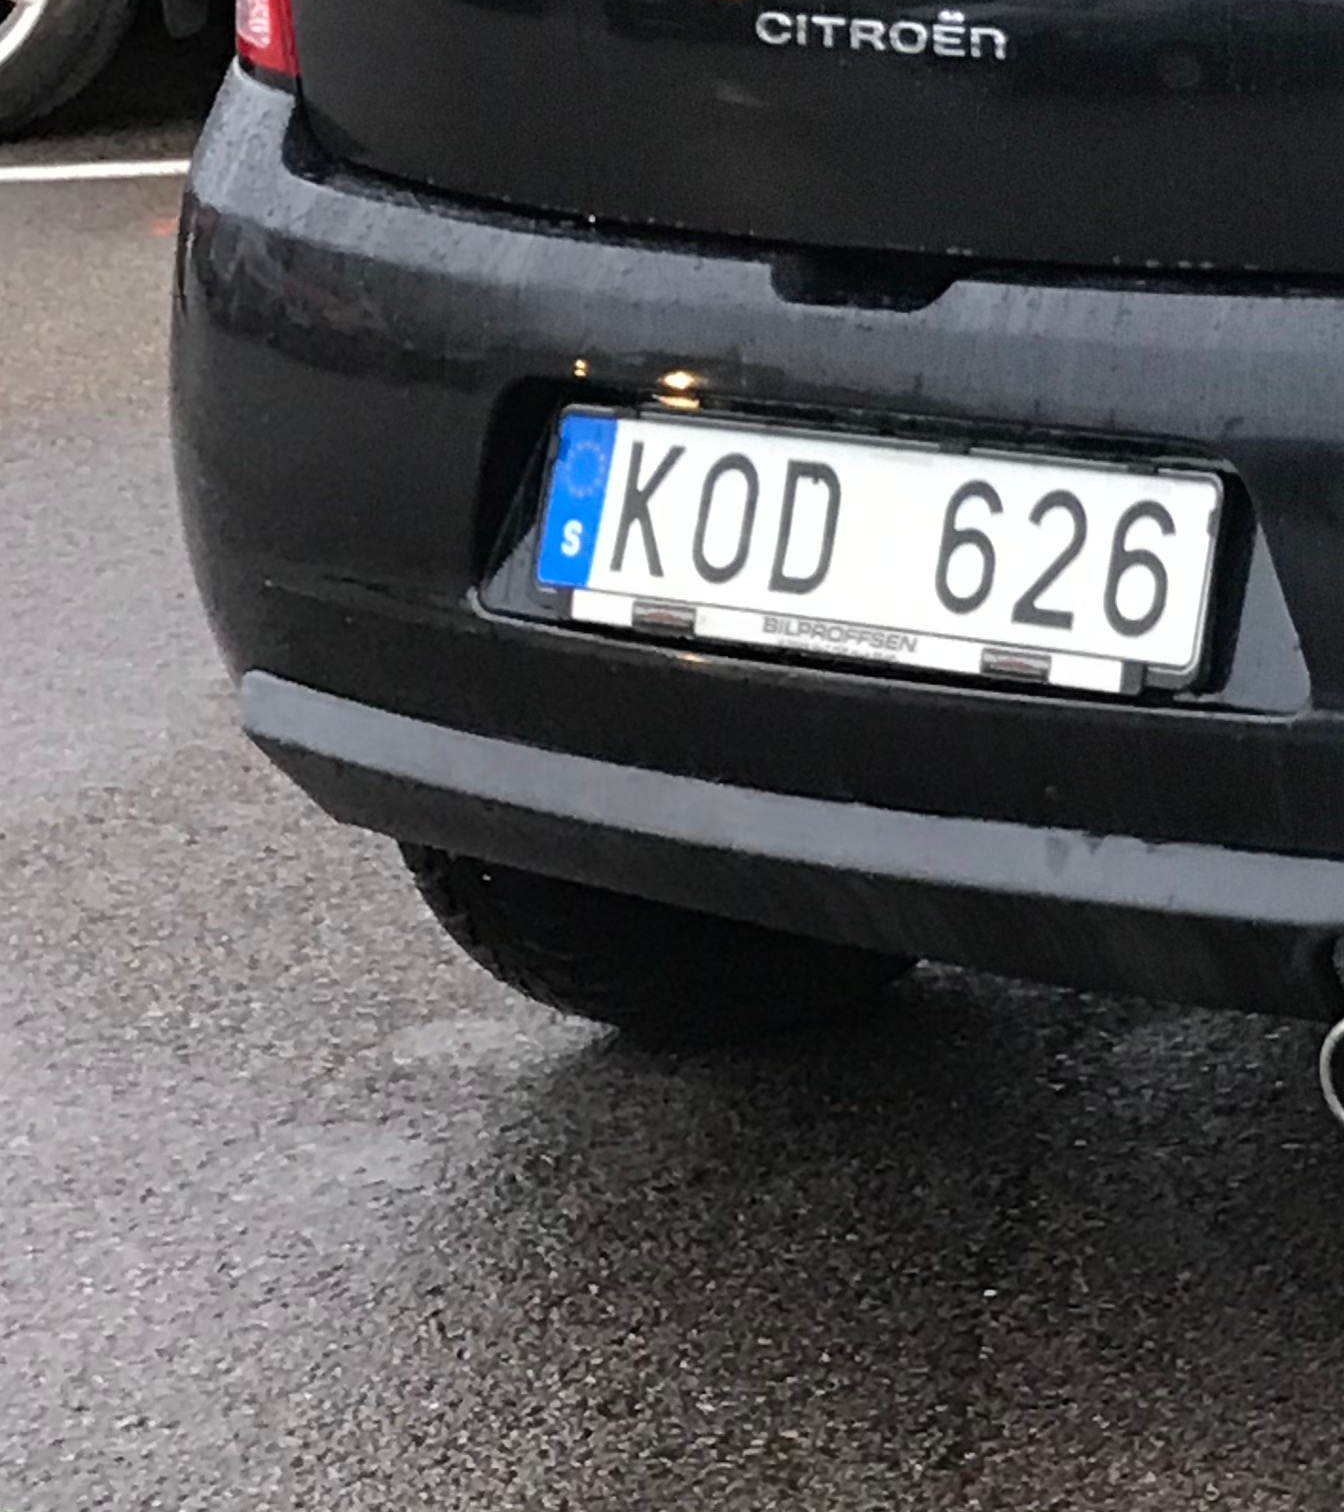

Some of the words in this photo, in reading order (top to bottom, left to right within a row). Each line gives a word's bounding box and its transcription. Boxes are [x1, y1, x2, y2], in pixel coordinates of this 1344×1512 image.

[755, 10, 1007, 60] CITROËN
[561, 519, 582, 559] S
[609, 440, 843, 595] KOD
[934, 479, 1178, 638] 626
[762, 615, 918, 653] BILPROFFSEN
